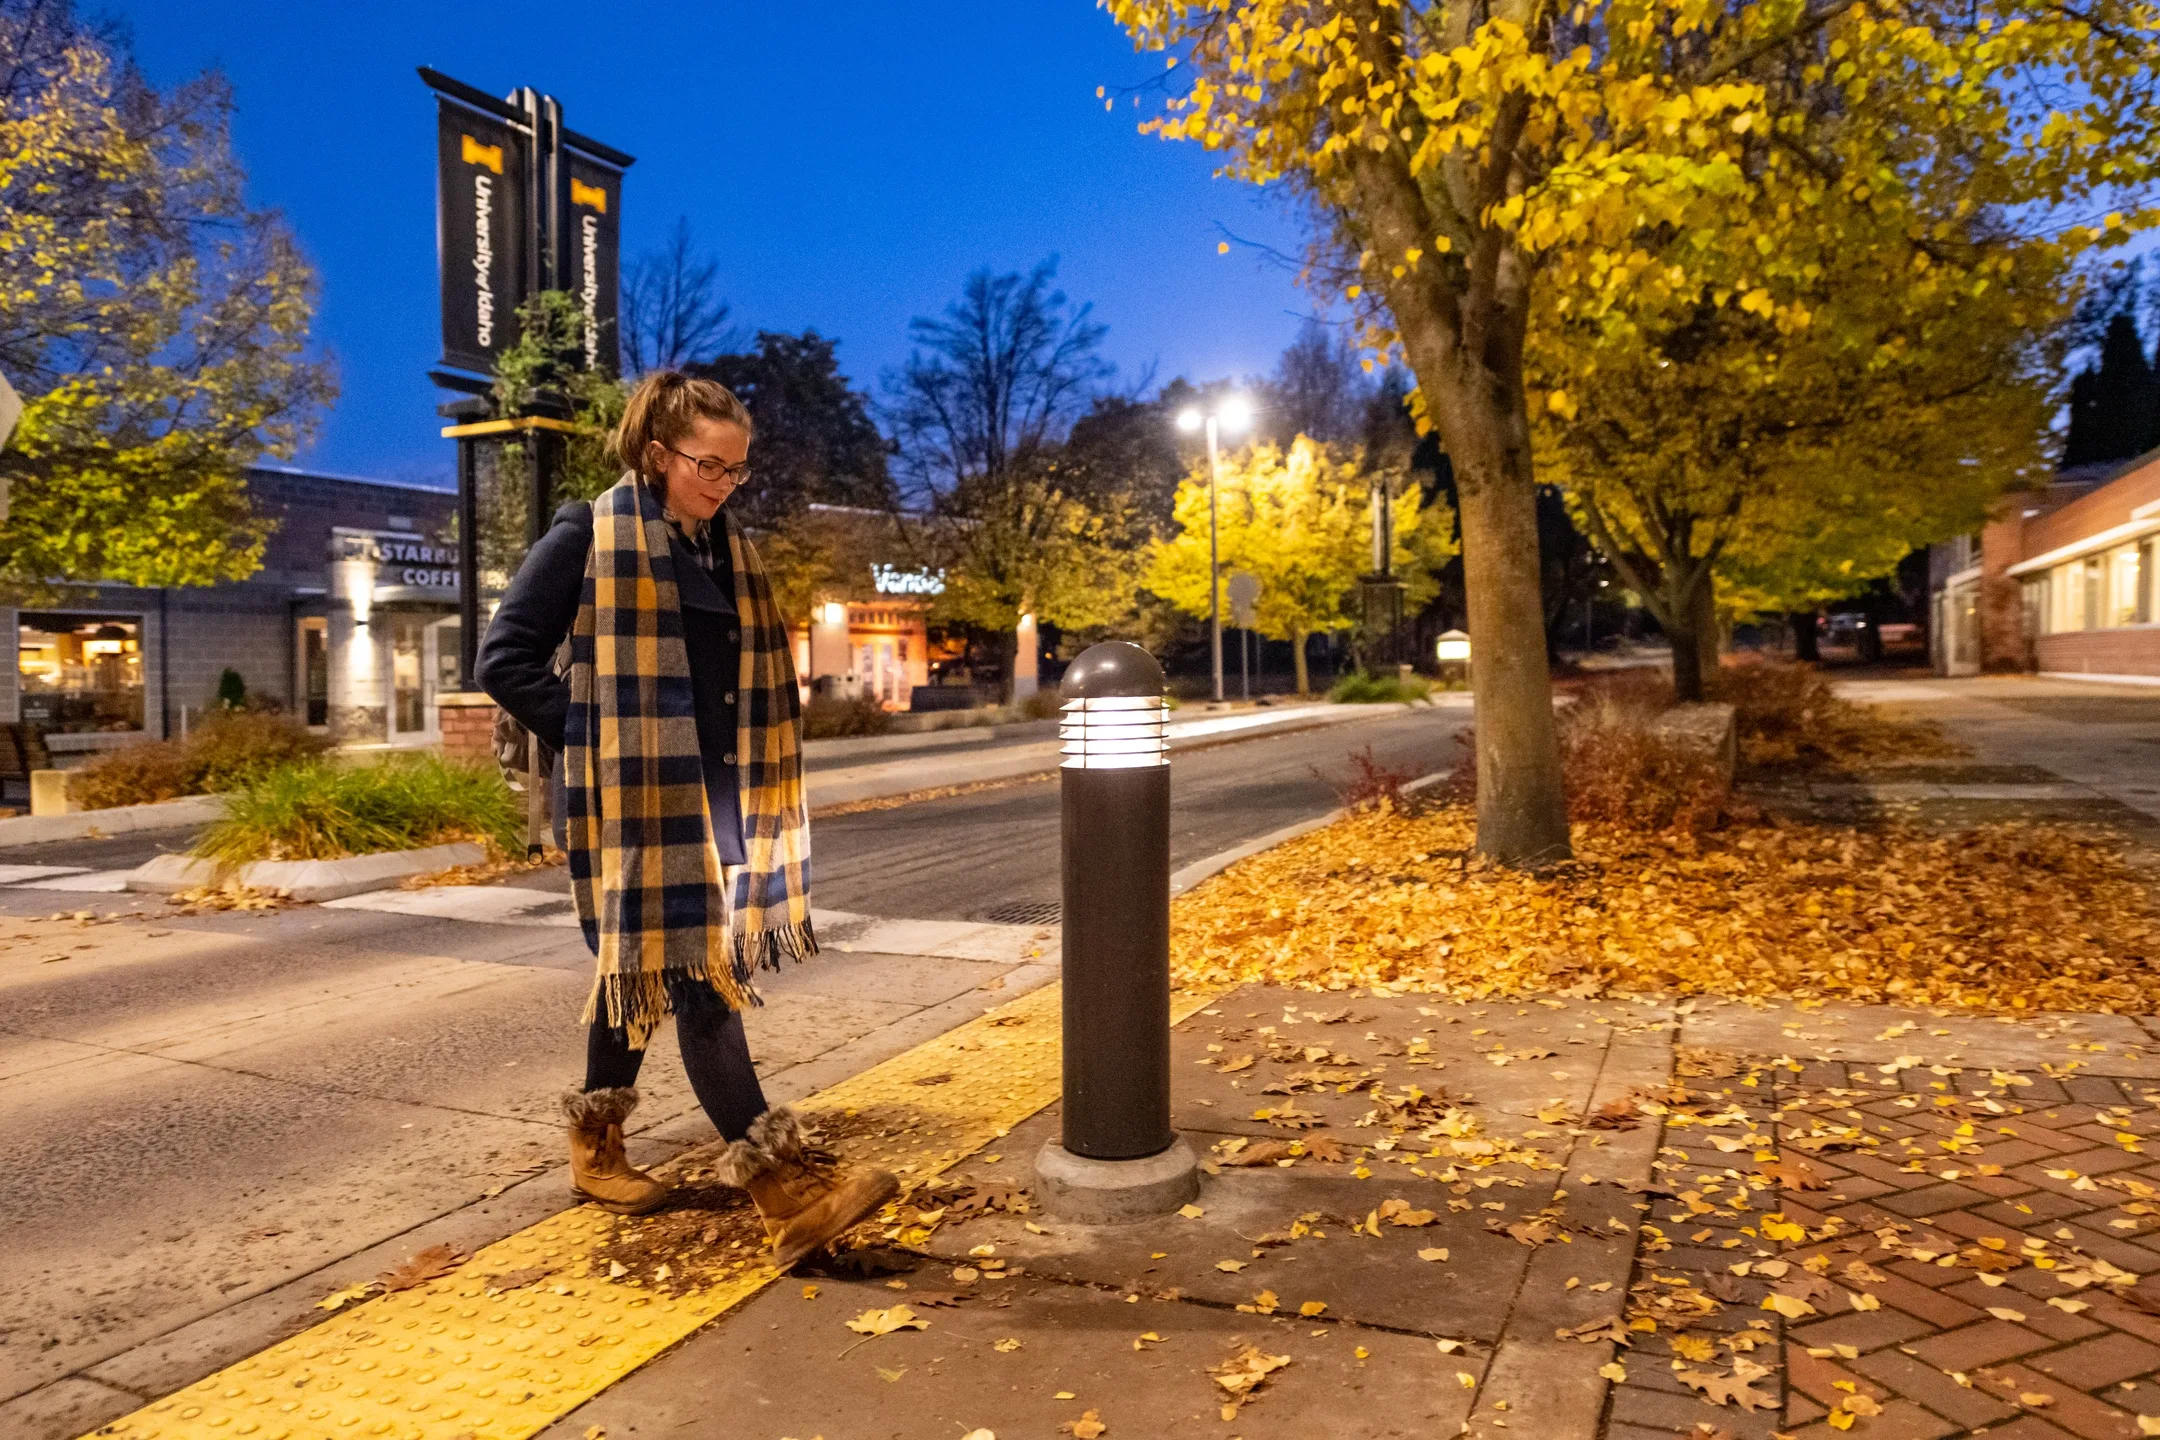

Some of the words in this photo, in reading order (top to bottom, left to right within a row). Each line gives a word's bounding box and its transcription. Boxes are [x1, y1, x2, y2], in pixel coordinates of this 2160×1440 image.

[473, 175, 493, 274] University
[580, 215, 599, 305] University
[477, 290, 495, 347] Idaho
